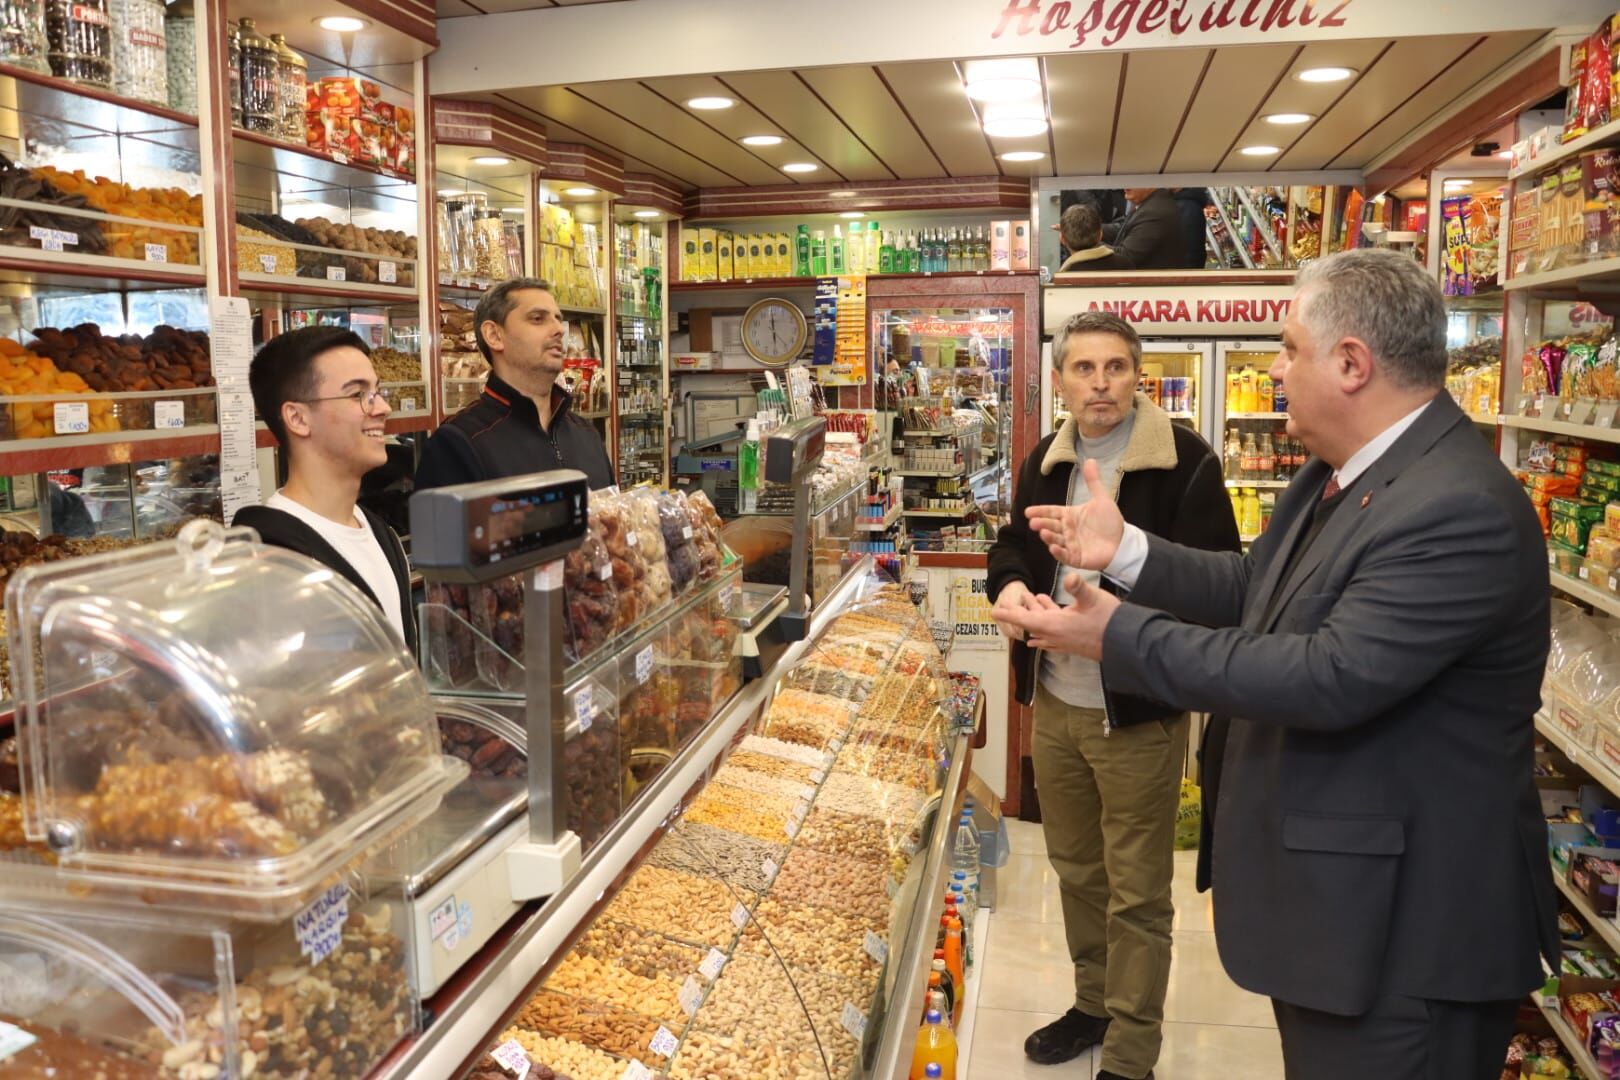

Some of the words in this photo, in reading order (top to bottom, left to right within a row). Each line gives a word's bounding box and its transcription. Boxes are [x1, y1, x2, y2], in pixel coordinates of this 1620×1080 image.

[1087, 300, 1191, 323] ANKARA
[971, 578, 988, 594] BUR
[955, 623, 979, 636] CEZASI
[980, 623, 989, 636] 75
[990, 623, 999, 636] TL
